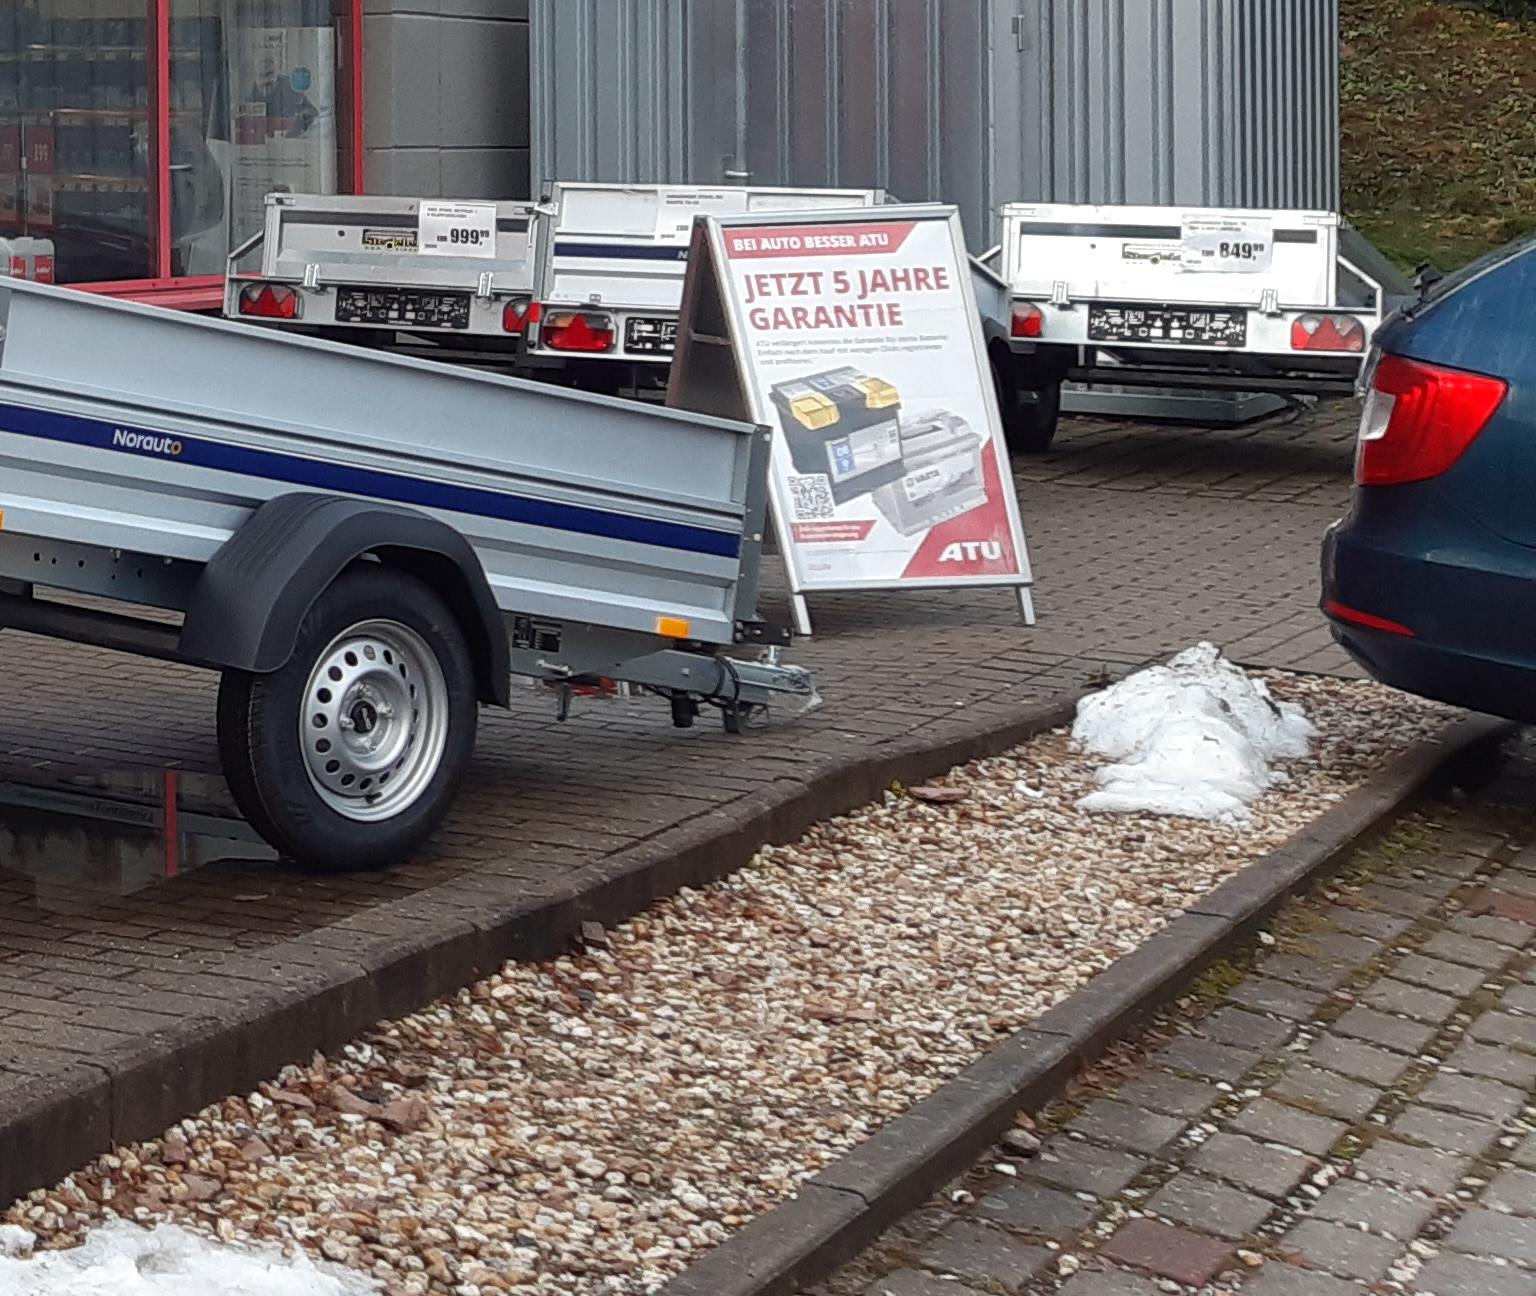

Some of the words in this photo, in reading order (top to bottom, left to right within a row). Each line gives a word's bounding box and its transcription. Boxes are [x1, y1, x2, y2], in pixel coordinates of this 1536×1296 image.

[733, 238, 757, 252] BEI
[760, 236, 801, 251] AUTO
[804, 234, 857, 249] BESSER
[858, 233, 889, 247] ATU
[743, 271, 824, 304] JETZT
[832, 270, 851, 295] 5
[856, 266, 950, 300] JAHRE
[748, 303, 904, 331] GARANTIE
[112, 428, 183, 456] Norauto
[936, 541, 1004, 562] ATU
